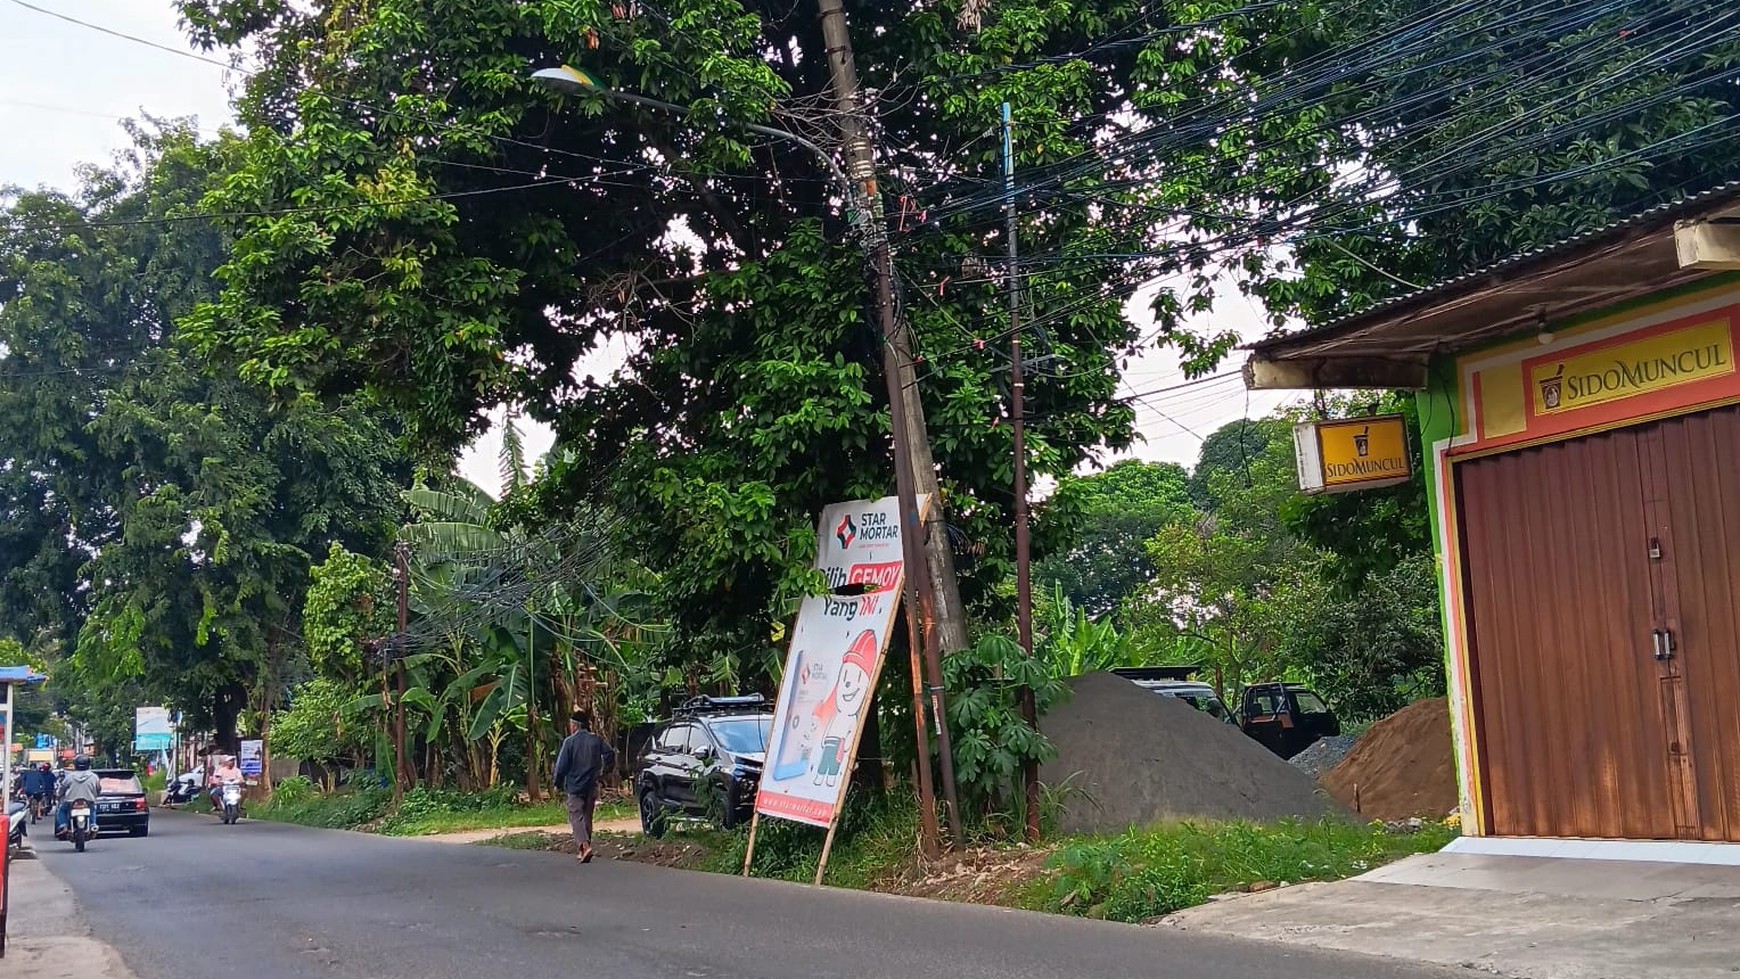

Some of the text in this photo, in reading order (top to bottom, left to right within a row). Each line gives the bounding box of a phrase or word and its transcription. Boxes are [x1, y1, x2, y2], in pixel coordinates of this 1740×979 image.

[1567, 344, 1726, 400] SIDOMUNCUL
[1327, 457, 1405, 478] SIDOMUNCUL
[861, 512, 887, 527] STAR
[859, 525, 898, 541] MORTAR
[820, 566, 848, 588] ilih
[823, 595, 858, 621] Yang
